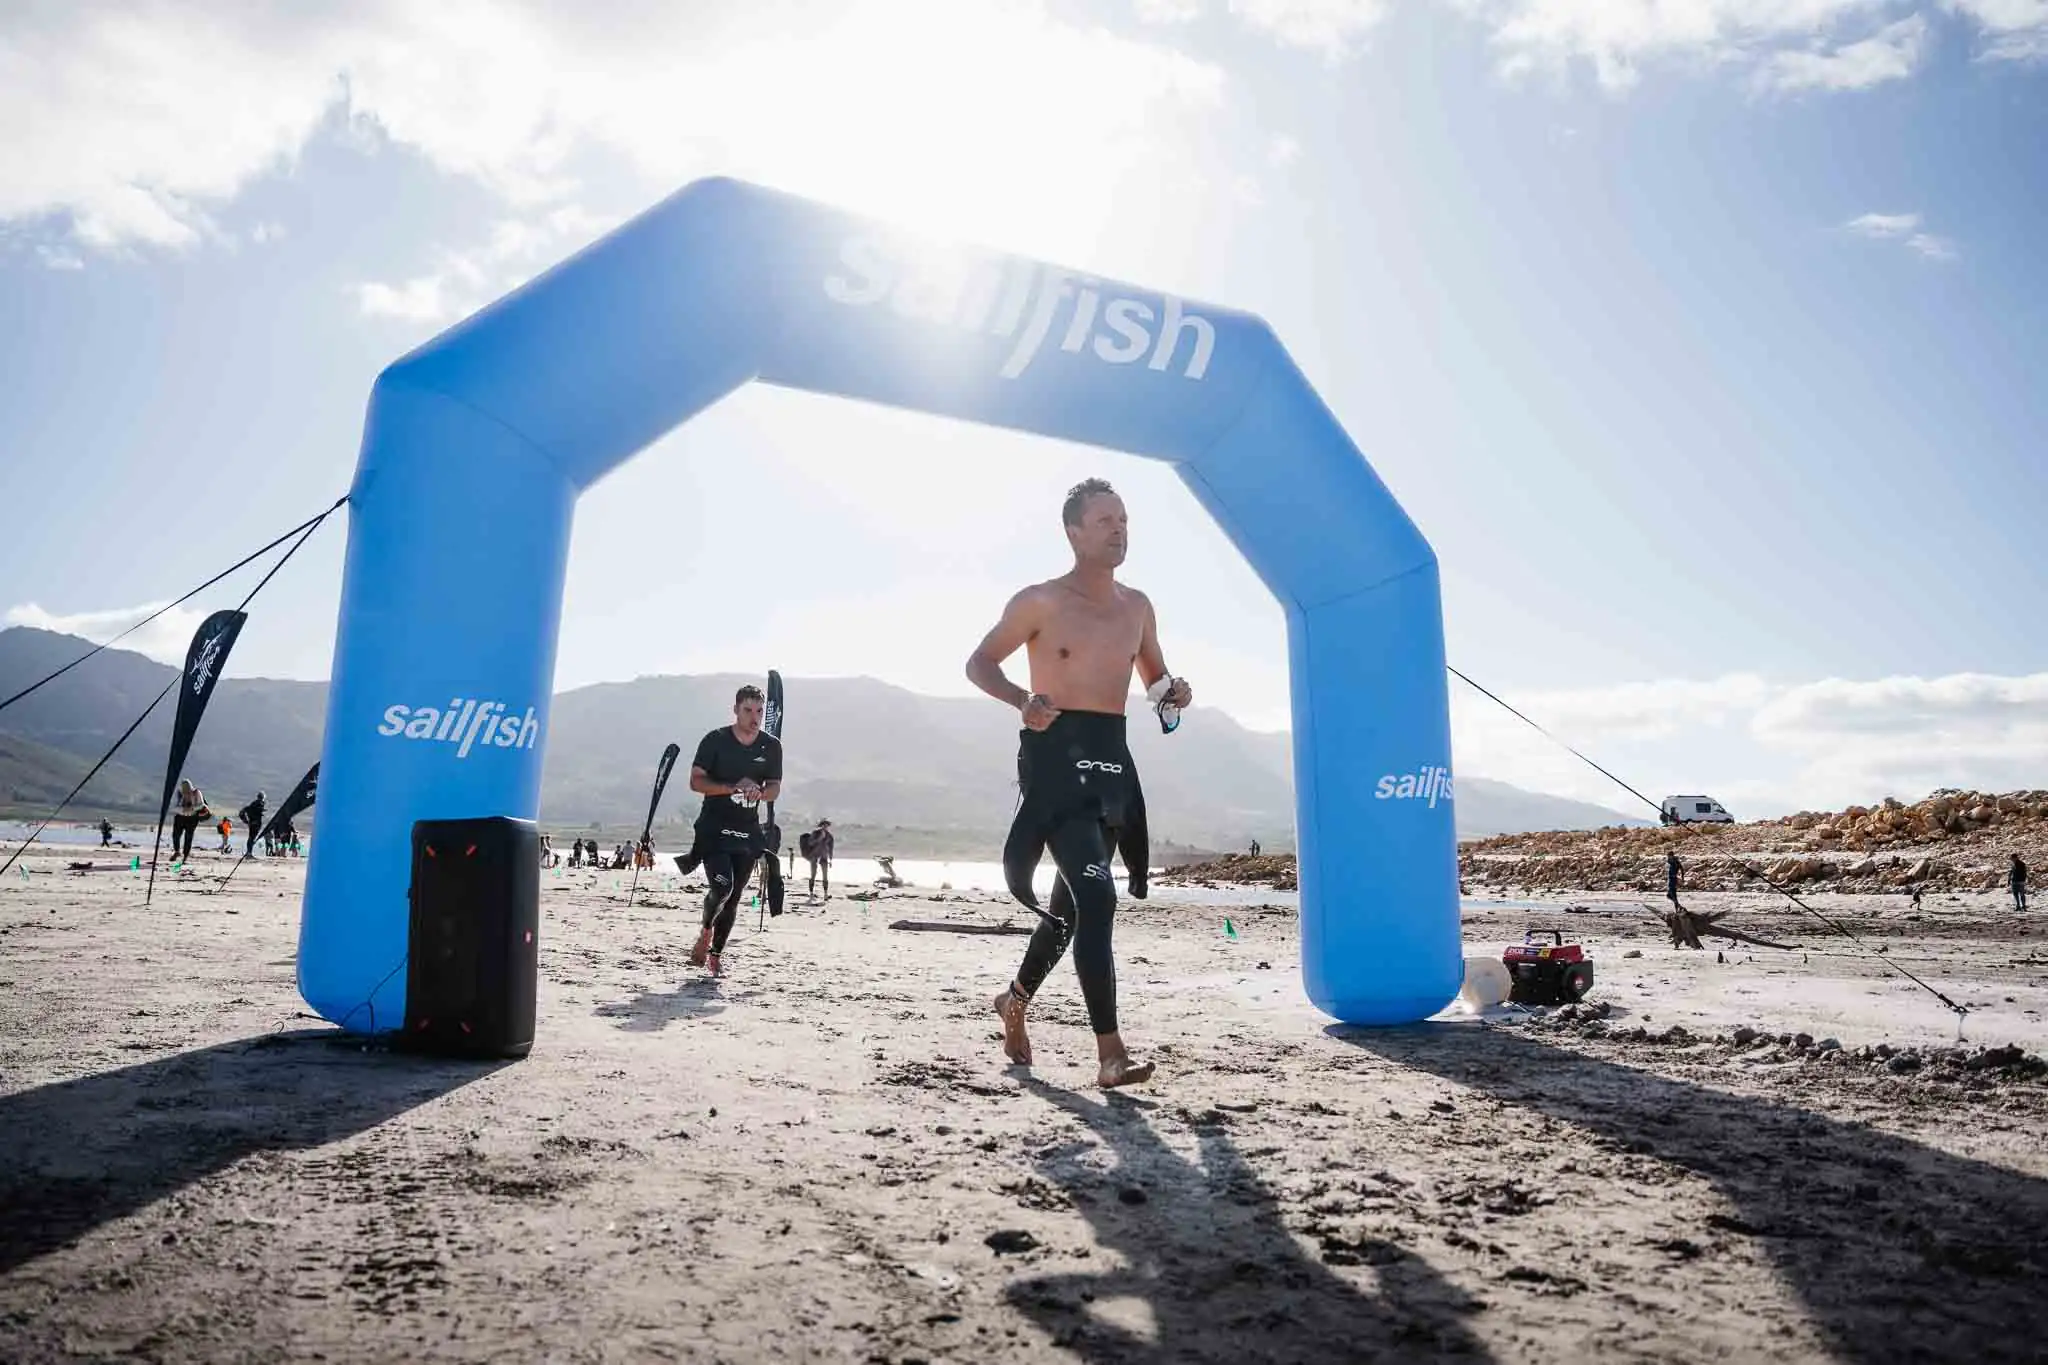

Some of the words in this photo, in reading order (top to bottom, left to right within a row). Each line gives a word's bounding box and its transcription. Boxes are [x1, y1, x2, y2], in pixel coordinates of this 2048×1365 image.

[377, 698, 538, 758] sailfish
[765, 700, 776, 735] sailfis
[1076, 760, 1122, 774] orca
[1375, 766, 1453, 809] sailfis
